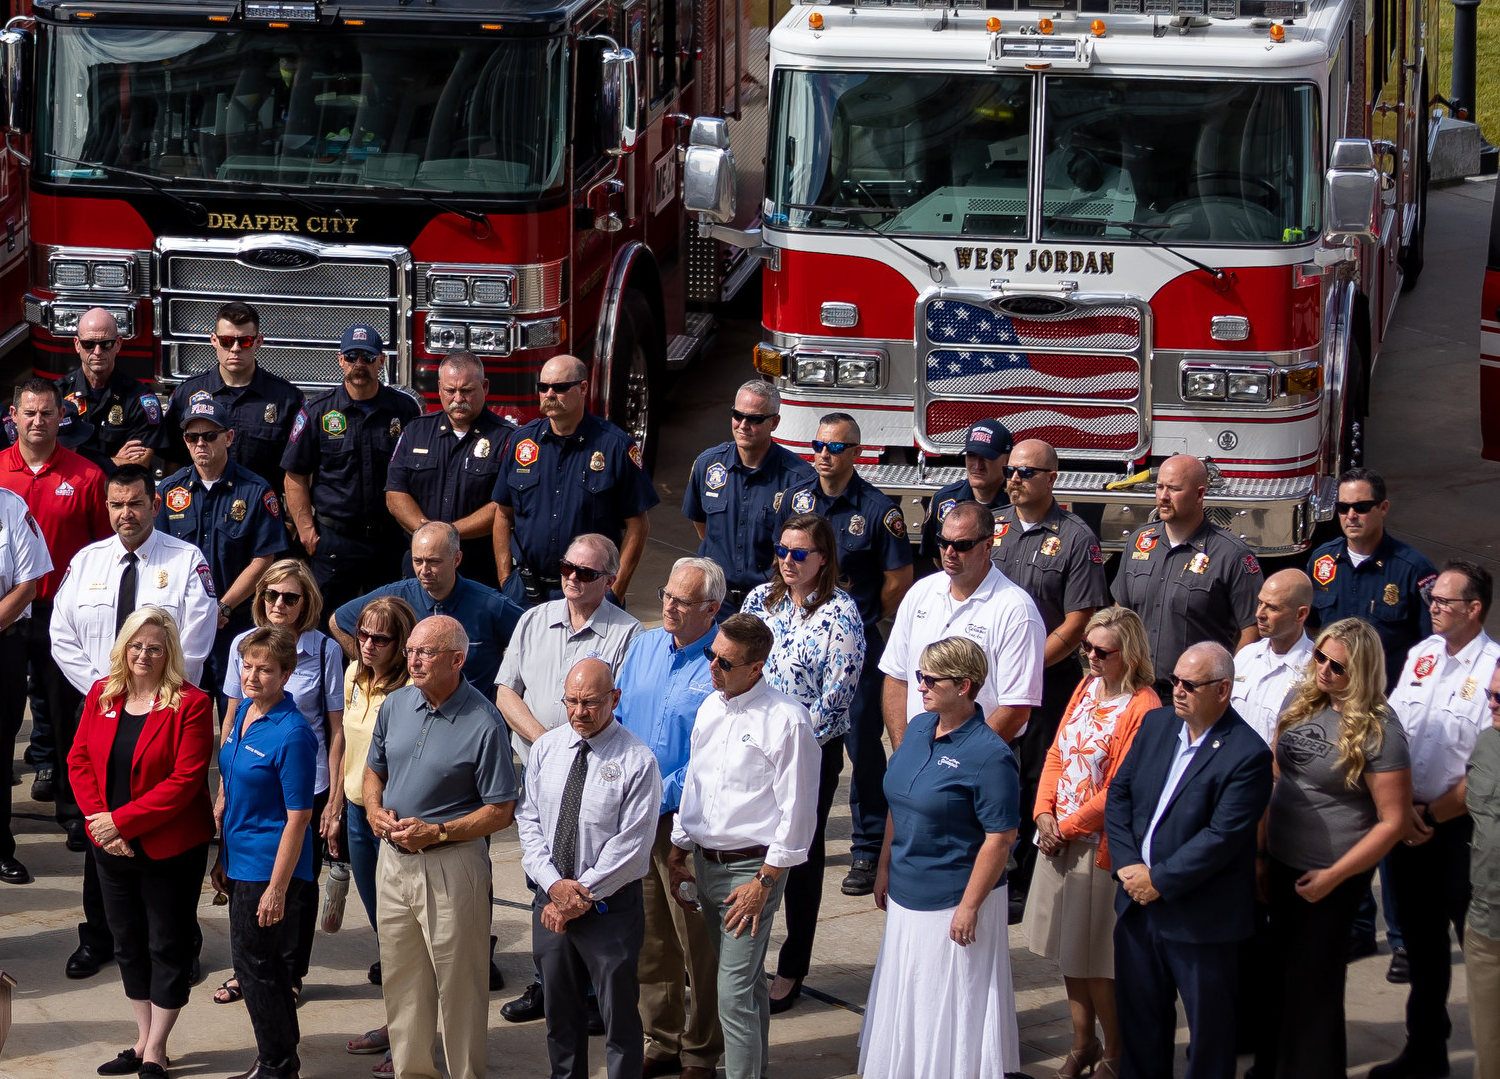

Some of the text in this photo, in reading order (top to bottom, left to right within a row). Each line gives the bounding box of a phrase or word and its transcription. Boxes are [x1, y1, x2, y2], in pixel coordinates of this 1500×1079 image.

[207, 213, 359, 234] DRAPER CITY
[954, 247, 1116, 275] WEST JORDAN
[191, 404, 214, 415] FIRE
[970, 431, 991, 443] FIRE
[1281, 733, 1328, 753] DRAPER
